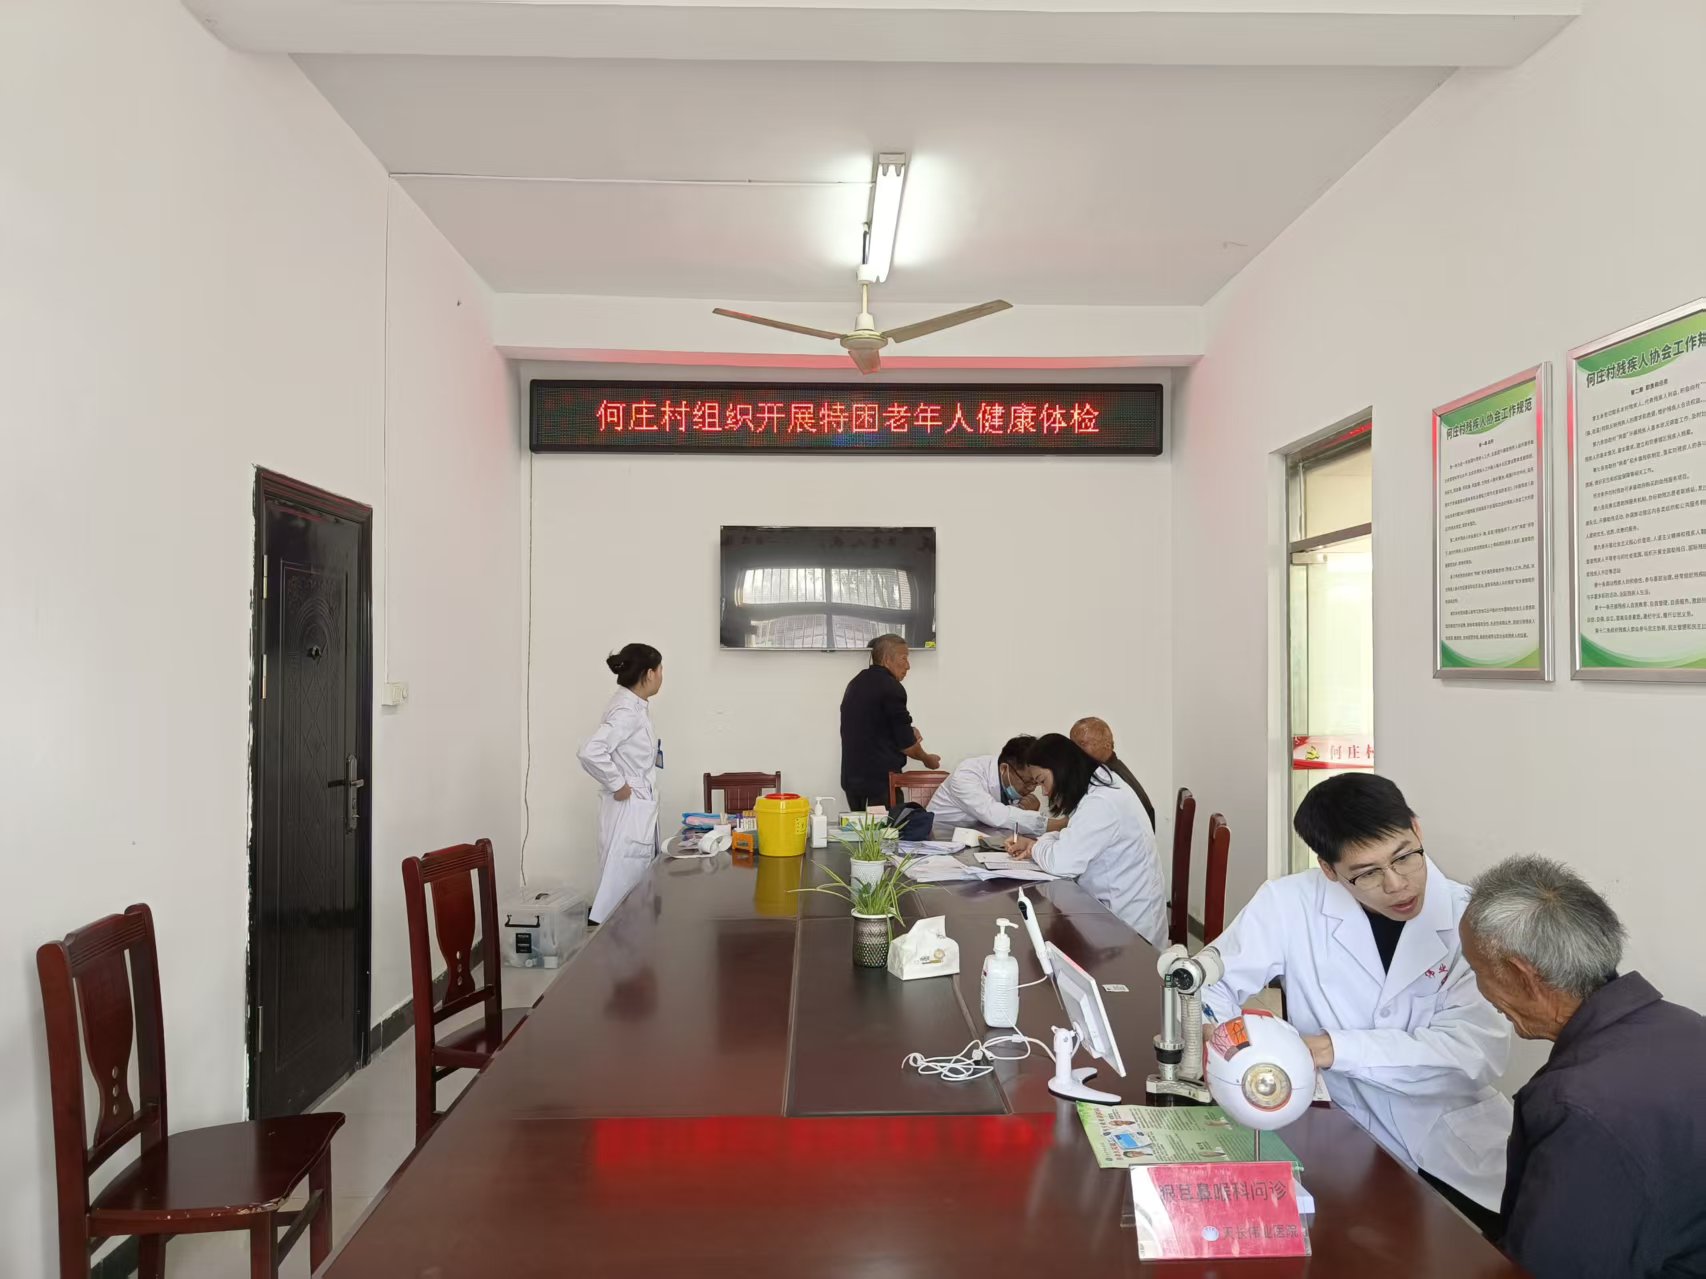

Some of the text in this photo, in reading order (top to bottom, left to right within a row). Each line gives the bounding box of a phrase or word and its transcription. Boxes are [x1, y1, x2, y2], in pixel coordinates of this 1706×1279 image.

[596, 399, 1101, 435] 何庄村组织开展特困老年人健康体检
[1446, 397, 1533, 440] 何庄村残疾人协会工作规范
